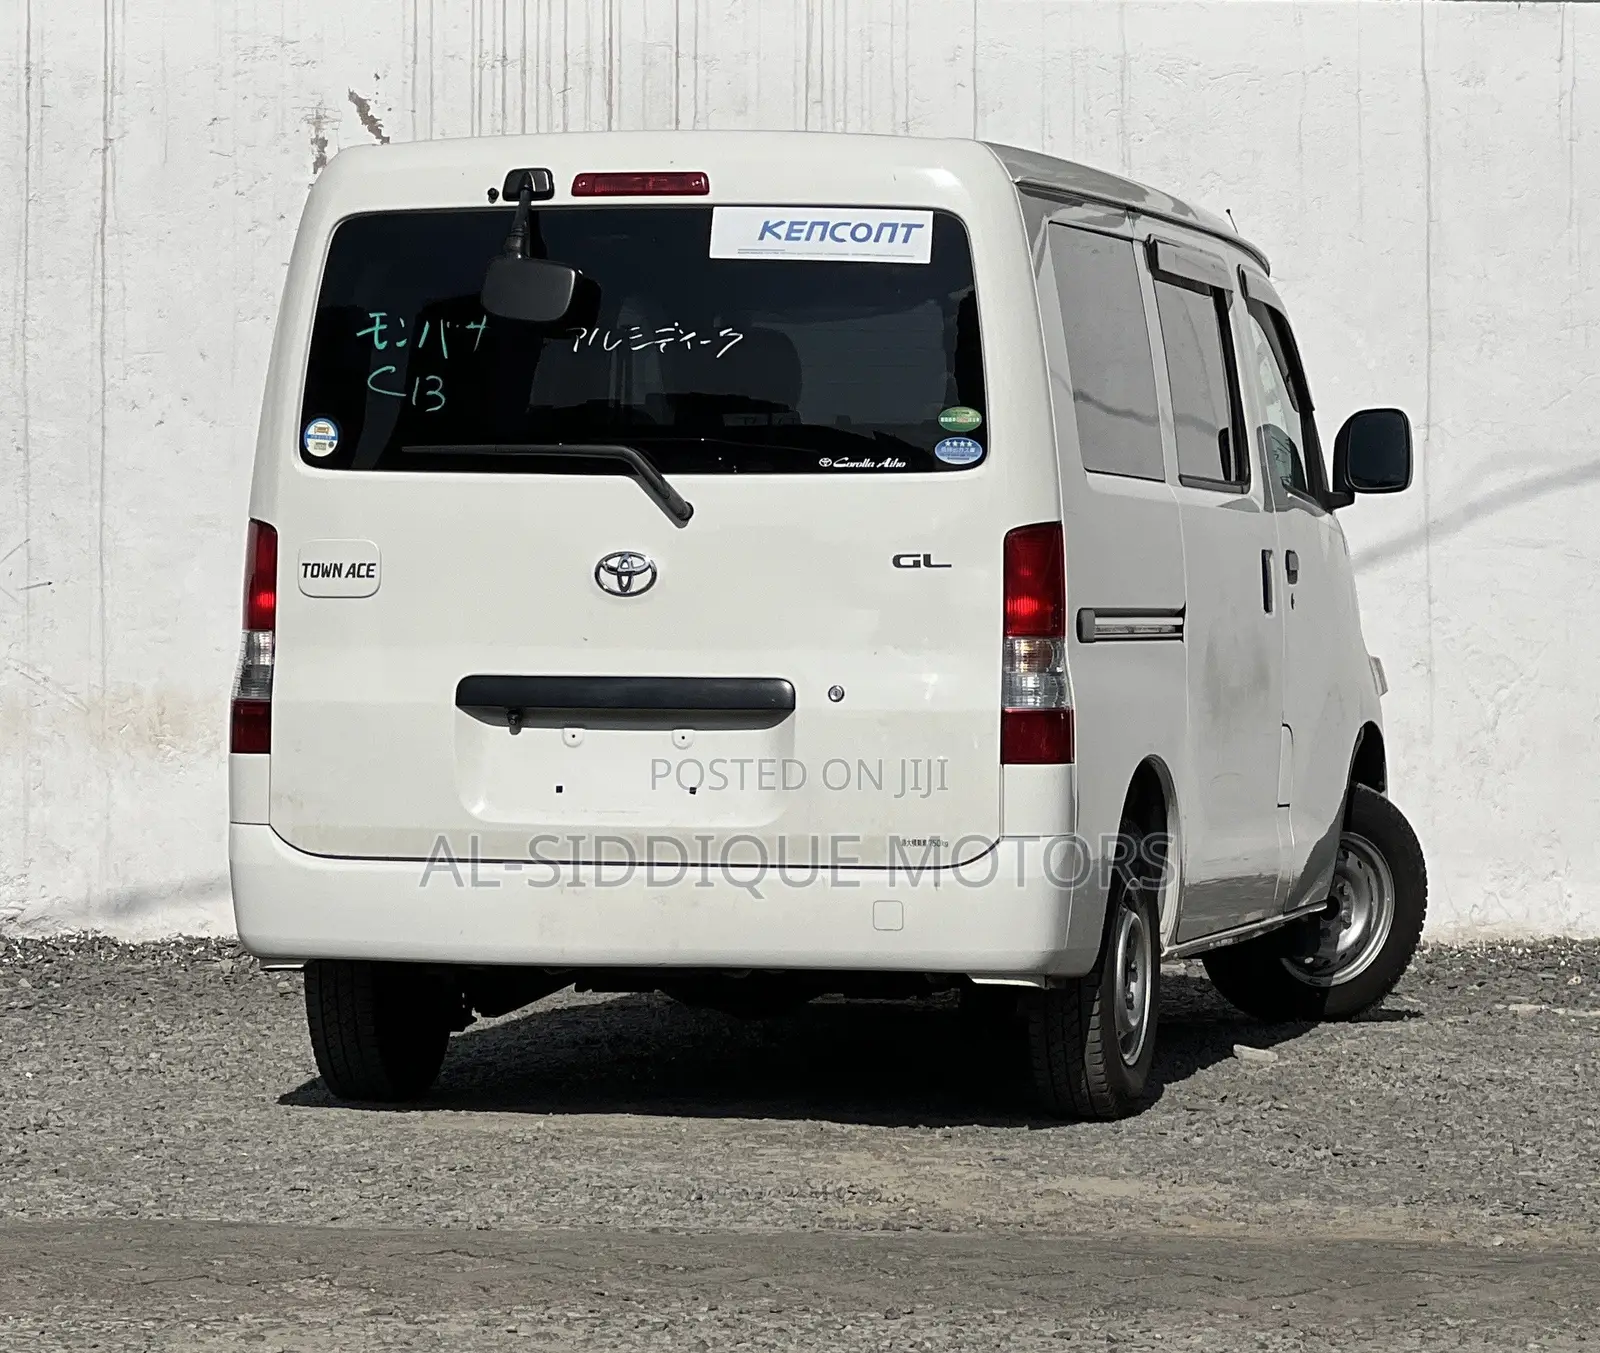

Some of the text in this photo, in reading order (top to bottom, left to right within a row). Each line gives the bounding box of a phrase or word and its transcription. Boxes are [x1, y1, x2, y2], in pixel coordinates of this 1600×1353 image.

[832, 456, 875, 468] Corolla
[892, 553, 952, 568] GL
[302, 563, 377, 578] TOWN ACE
